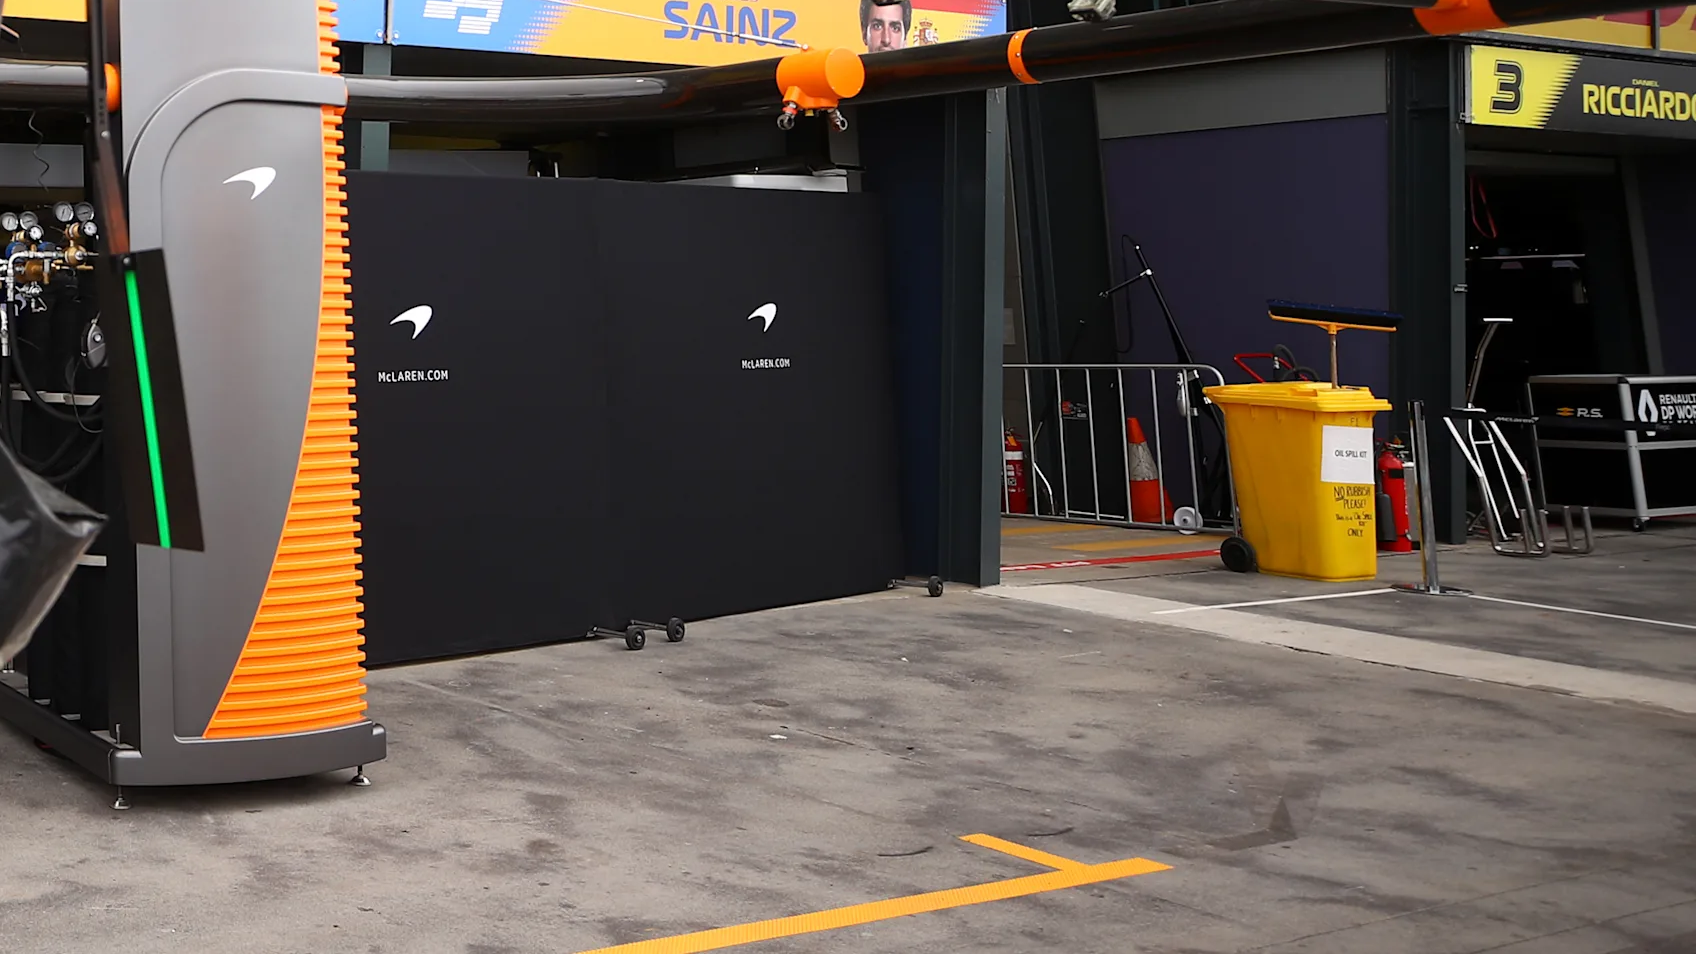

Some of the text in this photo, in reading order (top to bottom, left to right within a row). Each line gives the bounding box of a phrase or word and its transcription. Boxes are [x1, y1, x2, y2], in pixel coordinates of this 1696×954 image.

[663, 0, 797, 48] SAINZ
[1489, 59, 1525, 115] 3
[1632, 78, 1660, 88] DANIEL
[741, 358, 791, 369] McLAREN.COM
[378, 370, 449, 383] McLAREN.COM
[1659, 393, 1696, 405] RENAULT
[1577, 408, 1603, 418] R.S.
[1661, 405, 1675, 420] DP
[1335, 450, 1344, 458] OIL
[1345, 450, 1359, 458] SPILL
[1334, 486, 1345, 498] NO
[1348, 528, 1363, 537] ONLY
